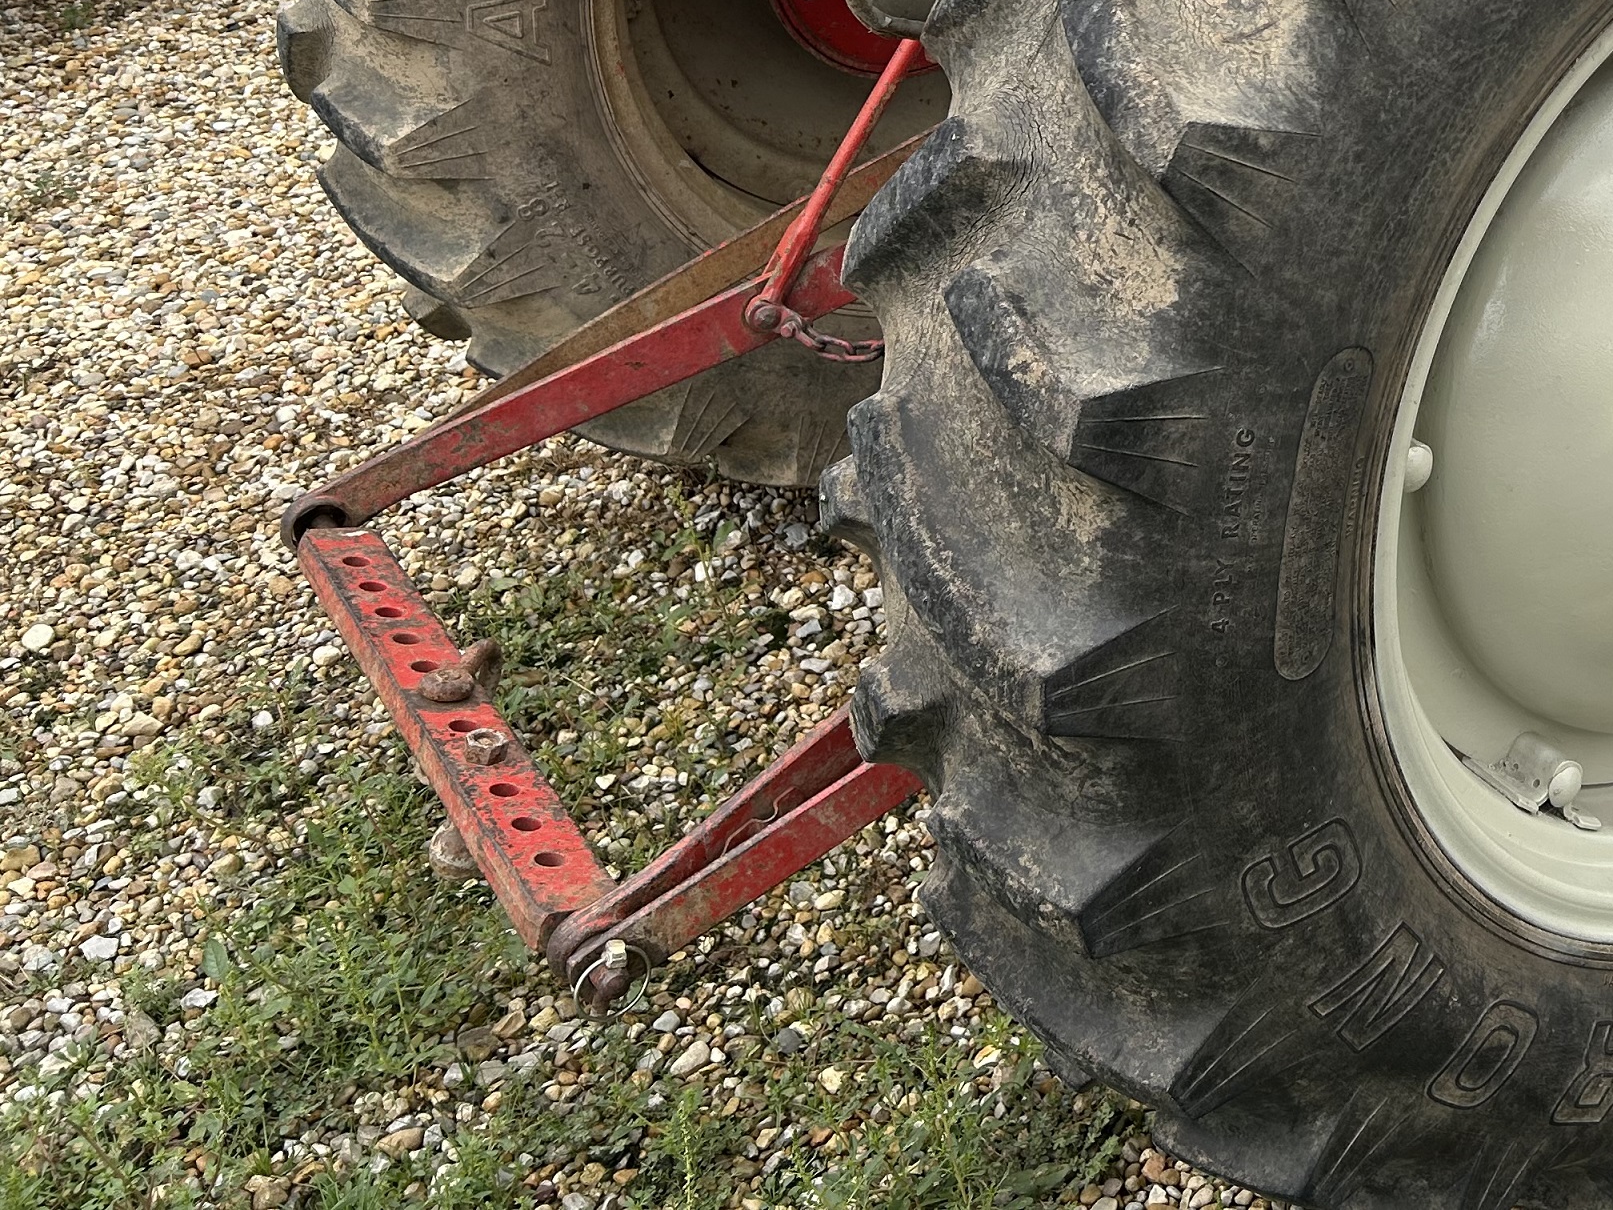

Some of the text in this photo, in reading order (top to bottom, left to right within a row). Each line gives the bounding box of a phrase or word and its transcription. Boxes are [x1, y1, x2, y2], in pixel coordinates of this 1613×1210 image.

[1220, 426, 1256, 540] RATING
[1212, 557, 1236, 608] PLY
[1211, 617, 1229, 635] 4
